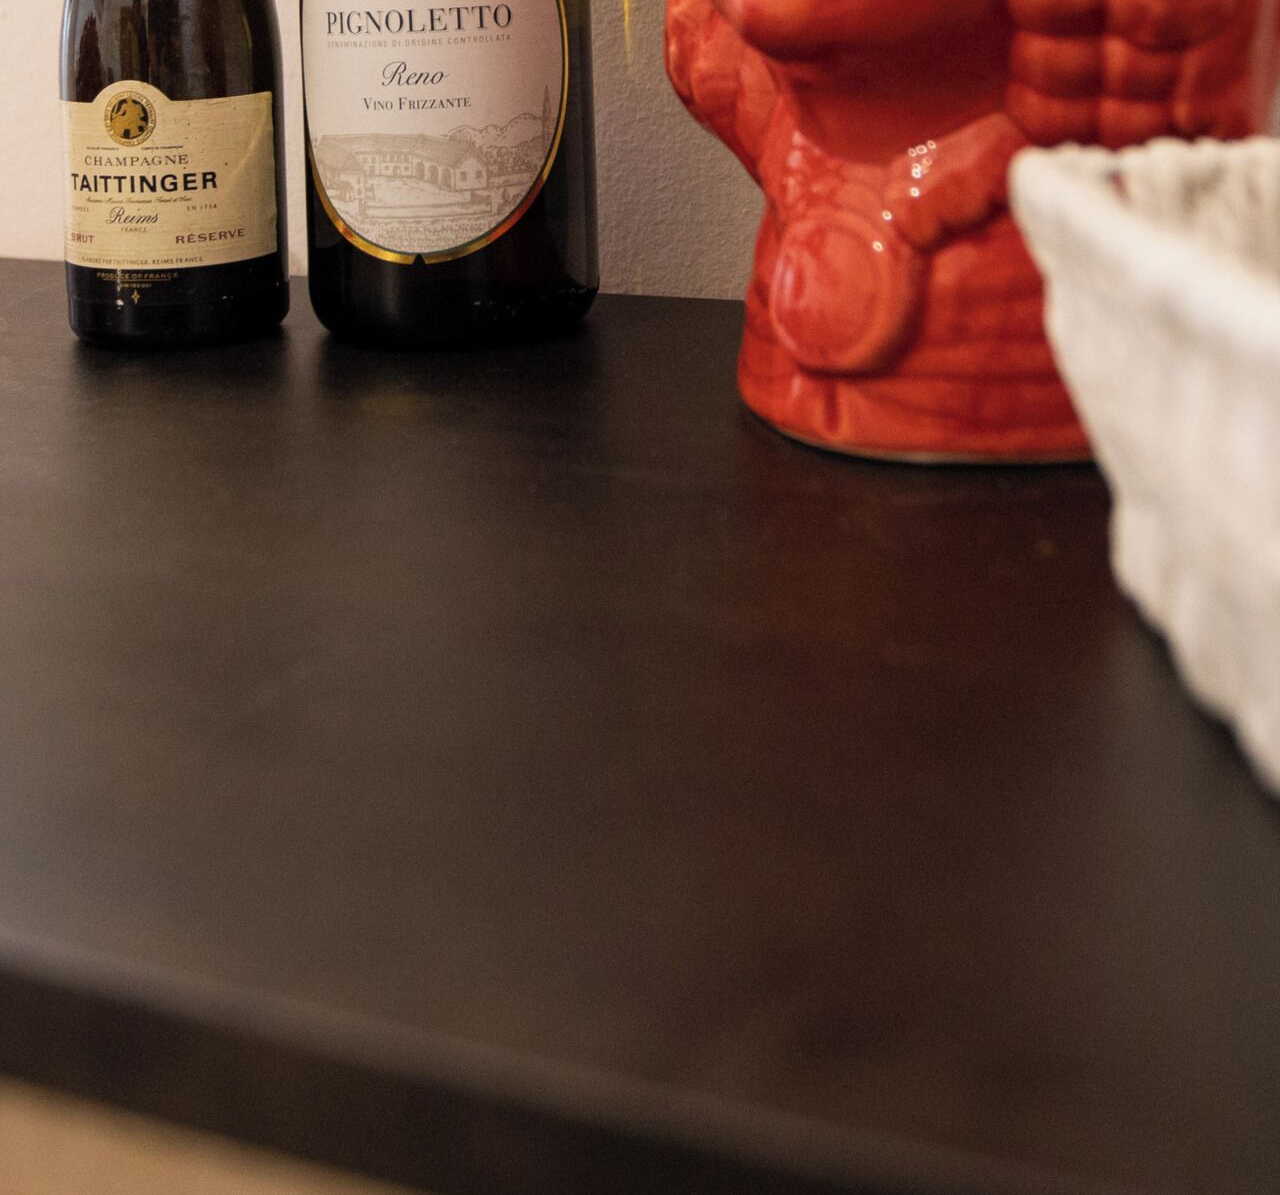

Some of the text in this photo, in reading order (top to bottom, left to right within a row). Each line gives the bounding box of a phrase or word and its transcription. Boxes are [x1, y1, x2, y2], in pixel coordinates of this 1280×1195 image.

[326, 4, 513, 35] PIGNOLETTO
[392, 39, 401, 48] DI
[405, 38, 443, 48] ORIGINE
[447, 34, 512, 44] CONTROLLATA
[381, 61, 450, 86] Reno
[84, 154, 189, 167] CHAMPAGNE
[71, 172, 217, 193] TAITTINGER
[105, 206, 159, 224] Reims
[71, 233, 95, 244] BRUT
